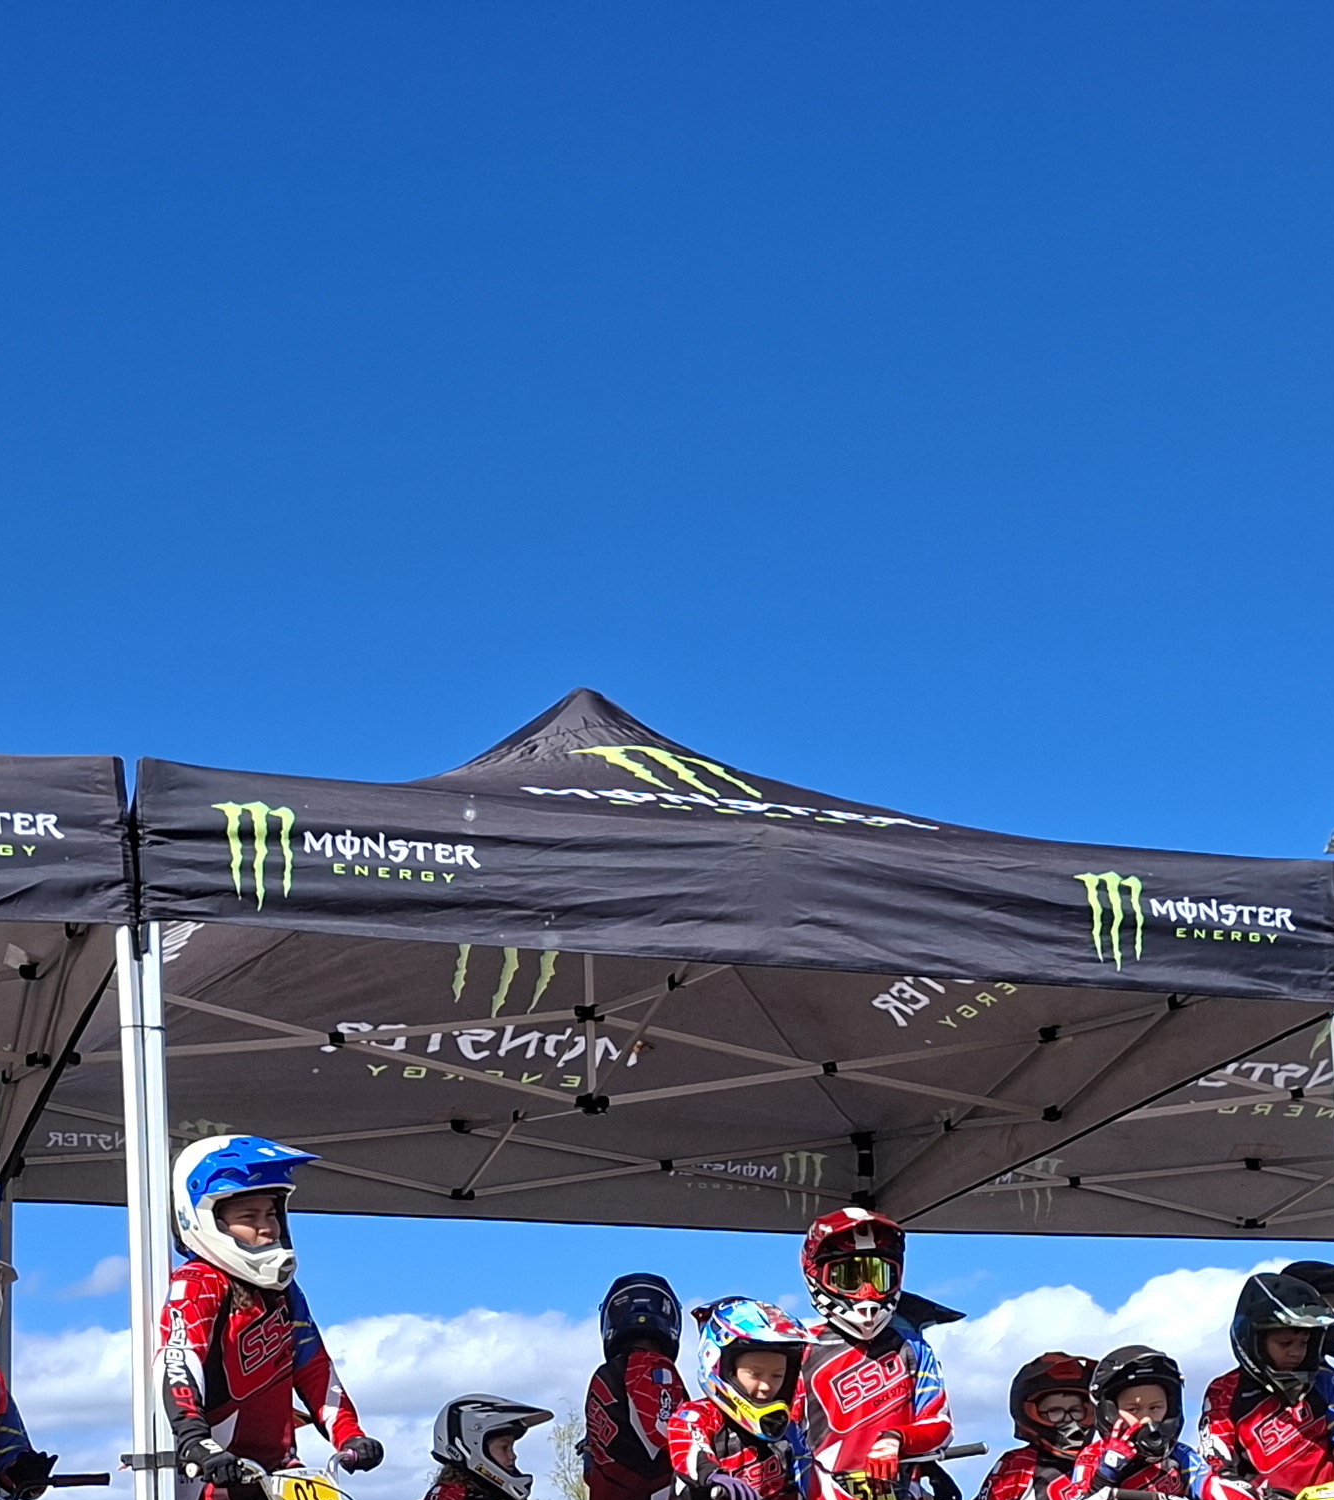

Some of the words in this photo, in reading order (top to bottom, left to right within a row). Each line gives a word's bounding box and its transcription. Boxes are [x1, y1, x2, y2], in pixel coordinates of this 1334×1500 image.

[303, 829, 482, 869] MONSTER
[333, 862, 456, 883] ENERGY
[1150, 897, 1296, 931] MONSTER
[1176, 928, 1278, 944] ENERGY
